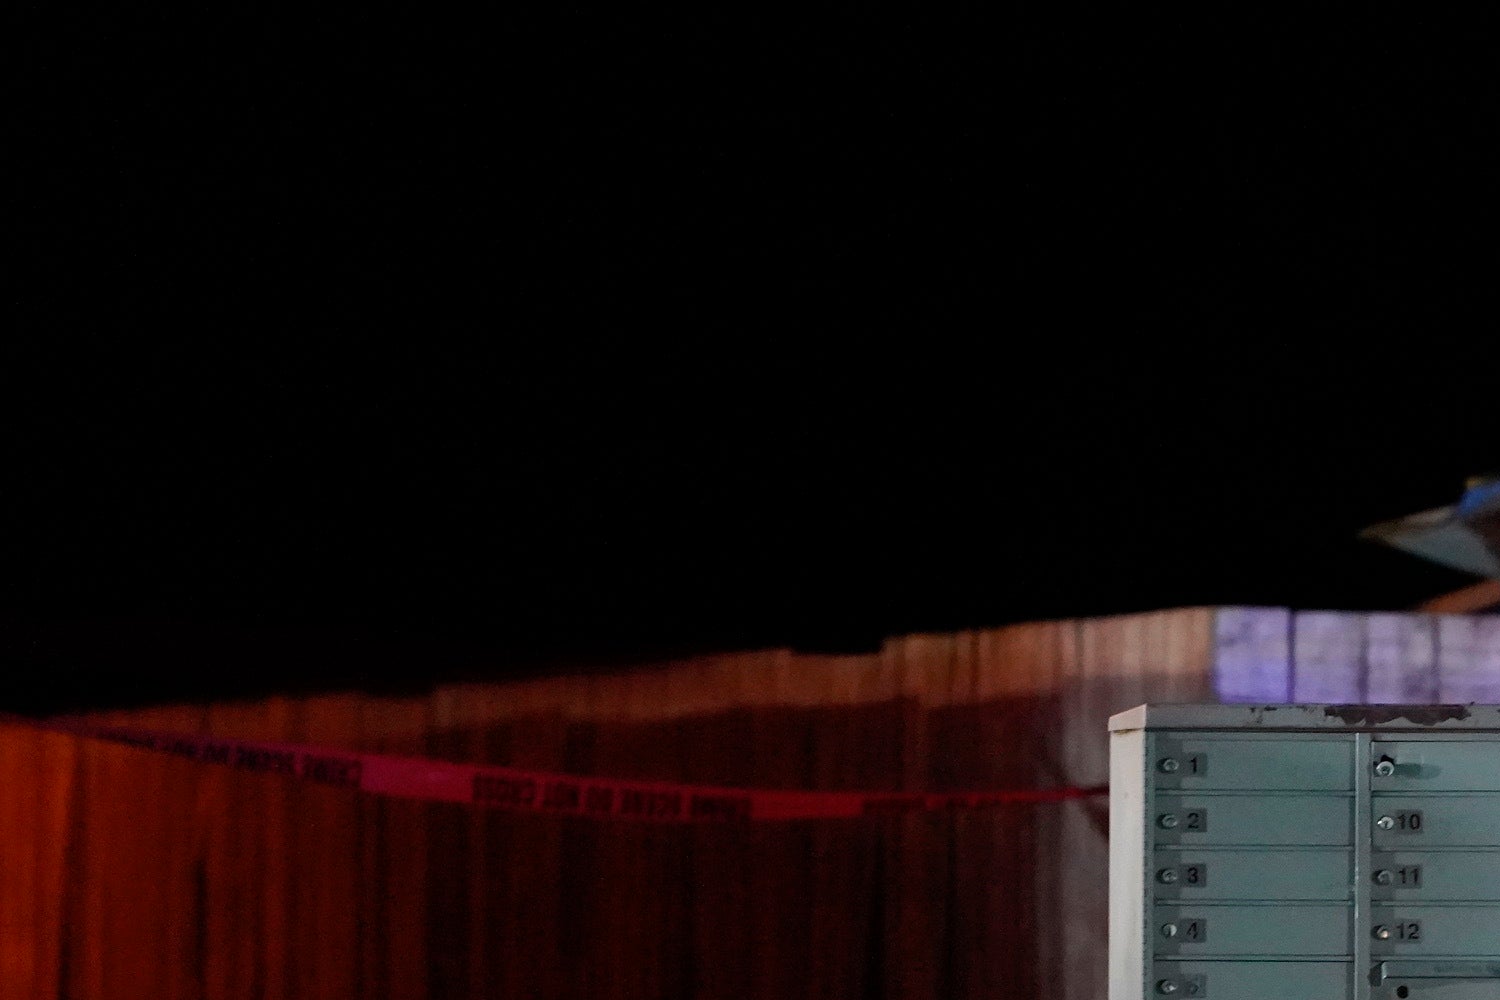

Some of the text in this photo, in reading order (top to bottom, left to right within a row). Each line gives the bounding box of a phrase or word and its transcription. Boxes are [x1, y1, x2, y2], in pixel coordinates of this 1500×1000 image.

[1190, 757, 1197, 774] 1
[1187, 812, 1199, 829] 2
[1398, 813, 1421, 831] 10
[1187, 867, 1198, 884] 3
[1398, 868, 1419, 885] 11
[1396, 924, 1420, 940] 12
